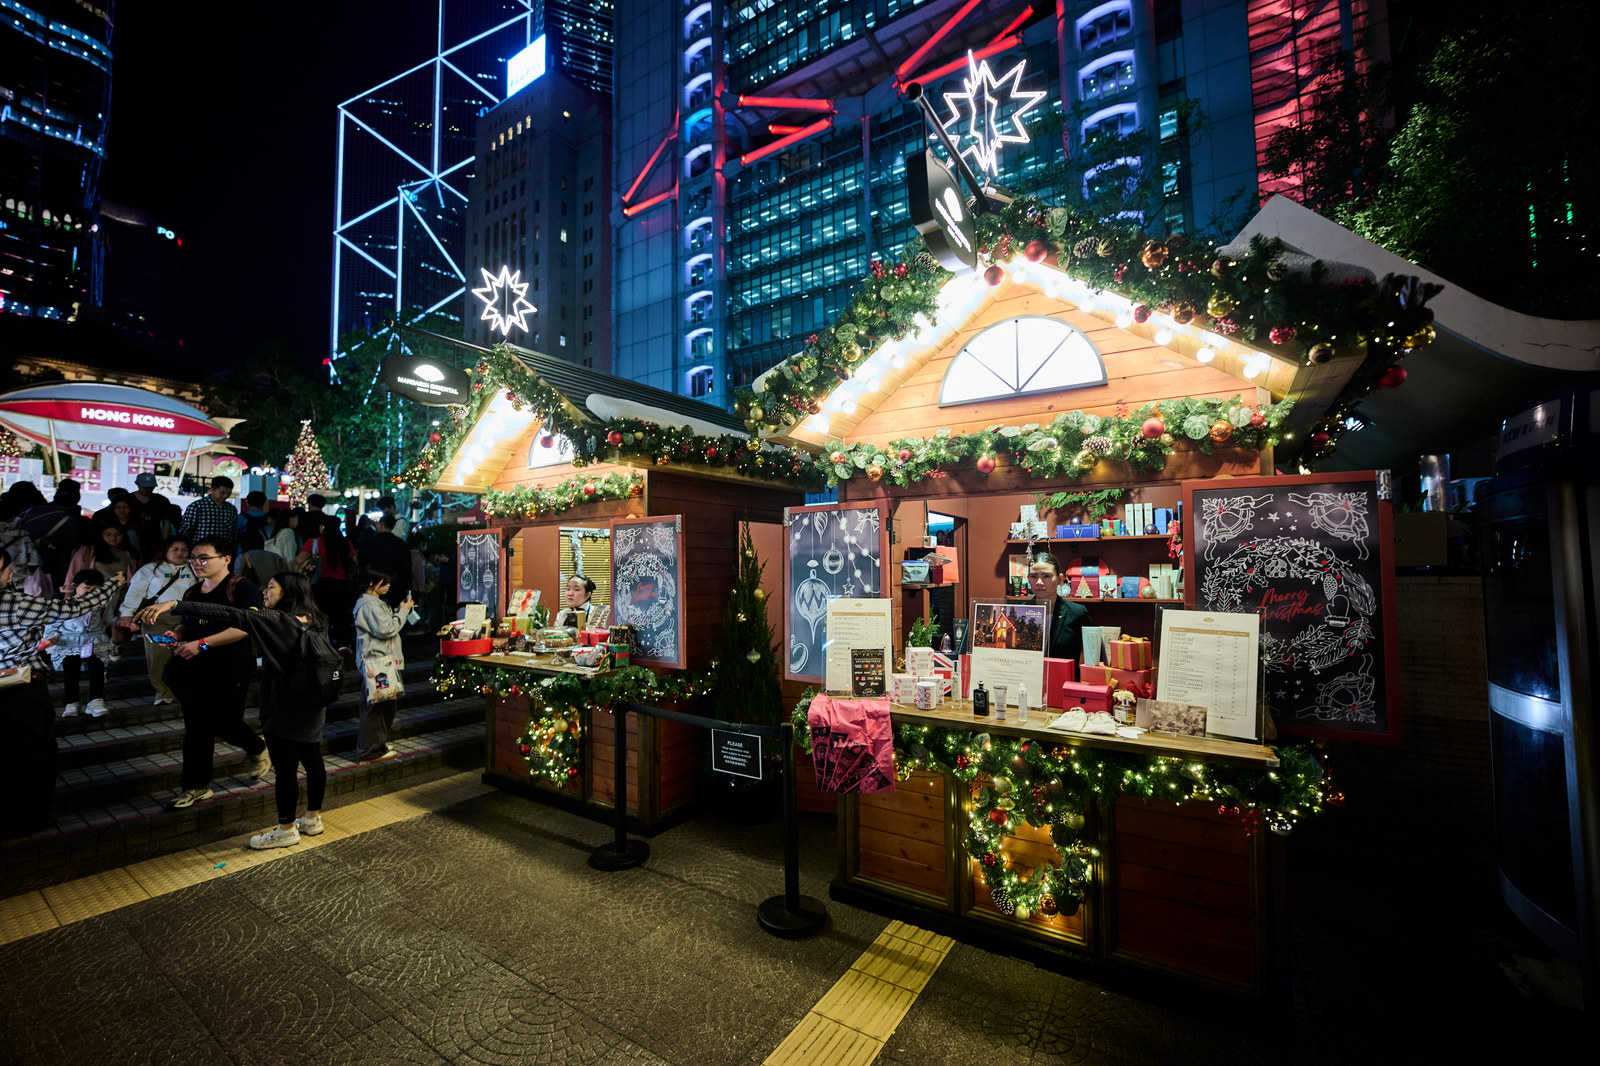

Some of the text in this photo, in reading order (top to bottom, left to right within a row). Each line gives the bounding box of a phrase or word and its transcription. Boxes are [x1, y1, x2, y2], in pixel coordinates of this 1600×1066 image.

[397, 376, 459, 395] MANDARIN ORIENTAL
[81, 408, 175, 429] HONG KONG
[77, 442, 177, 459] WELCOMES YOU
[1260, 587, 1310, 607] Merry
